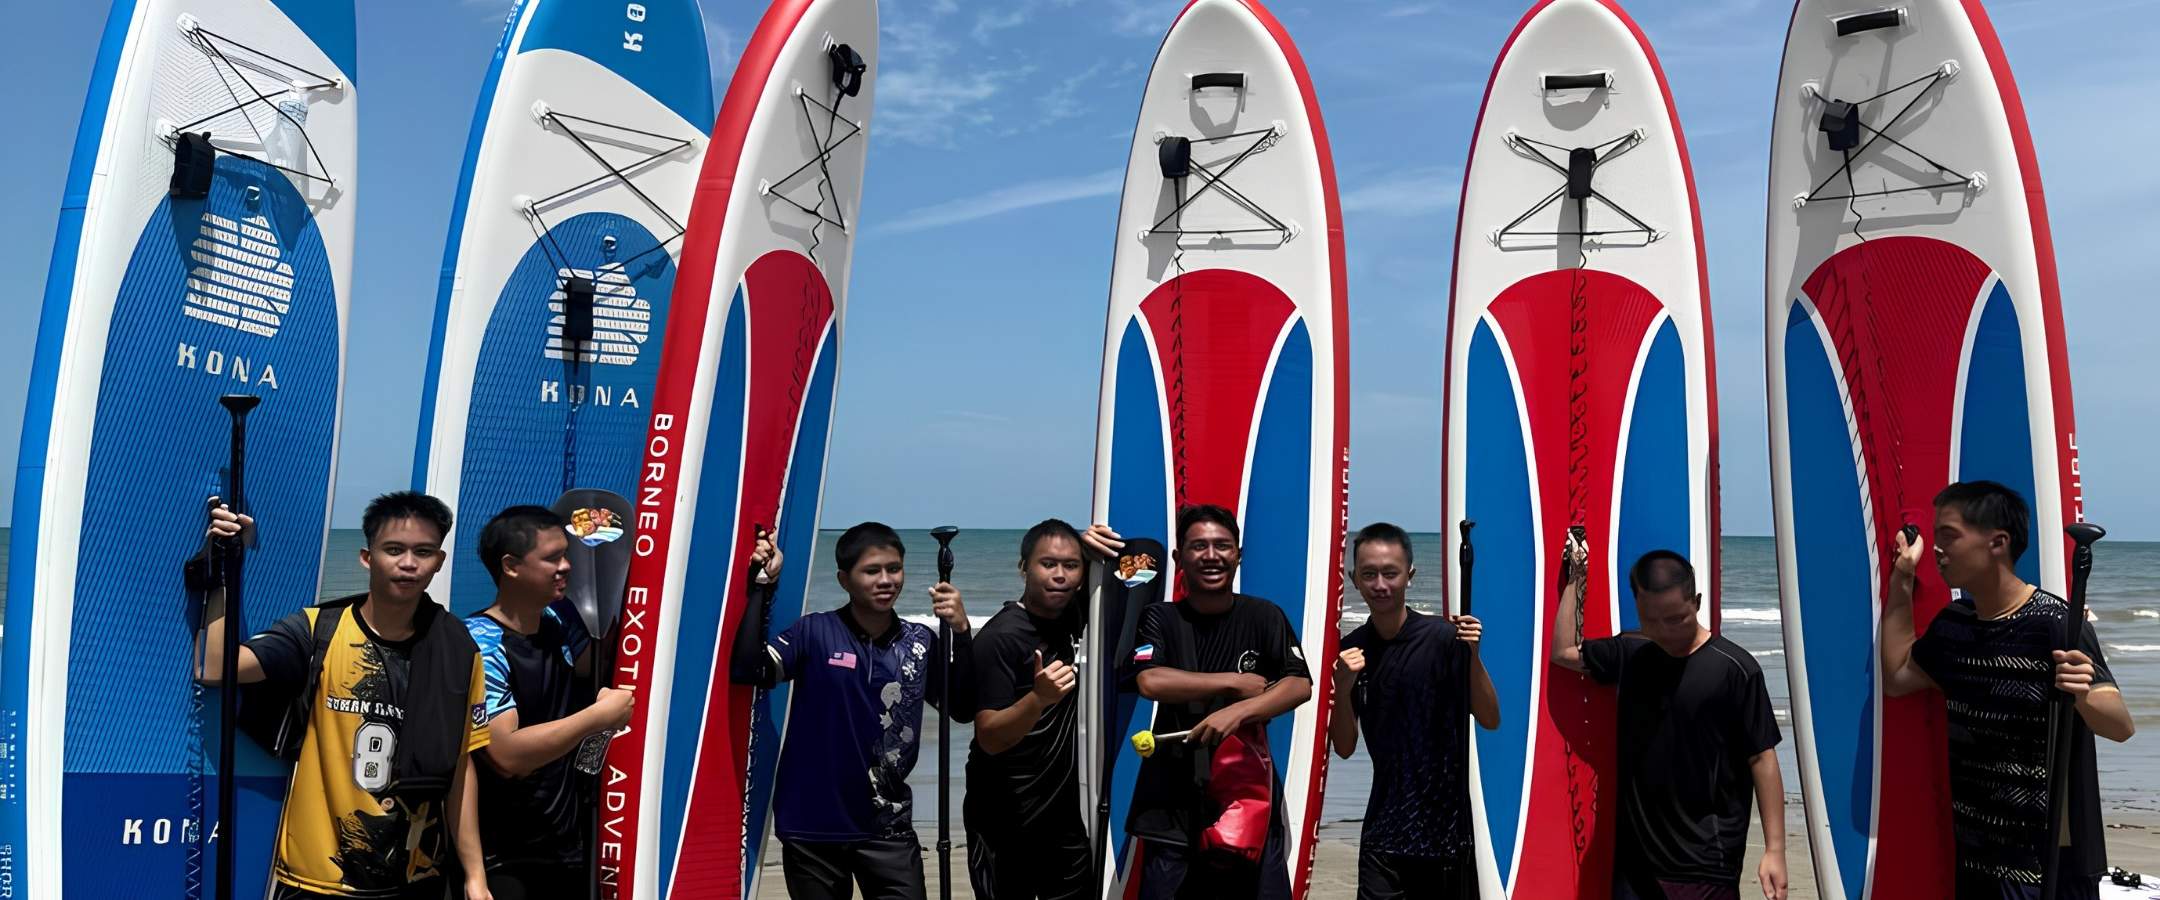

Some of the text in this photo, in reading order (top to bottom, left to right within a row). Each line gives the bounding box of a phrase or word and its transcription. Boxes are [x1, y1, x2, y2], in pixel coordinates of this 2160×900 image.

[177, 342, 278, 390] KONA
[540, 380, 640, 408] KONA
[635, 413, 674, 557] BORNEO
